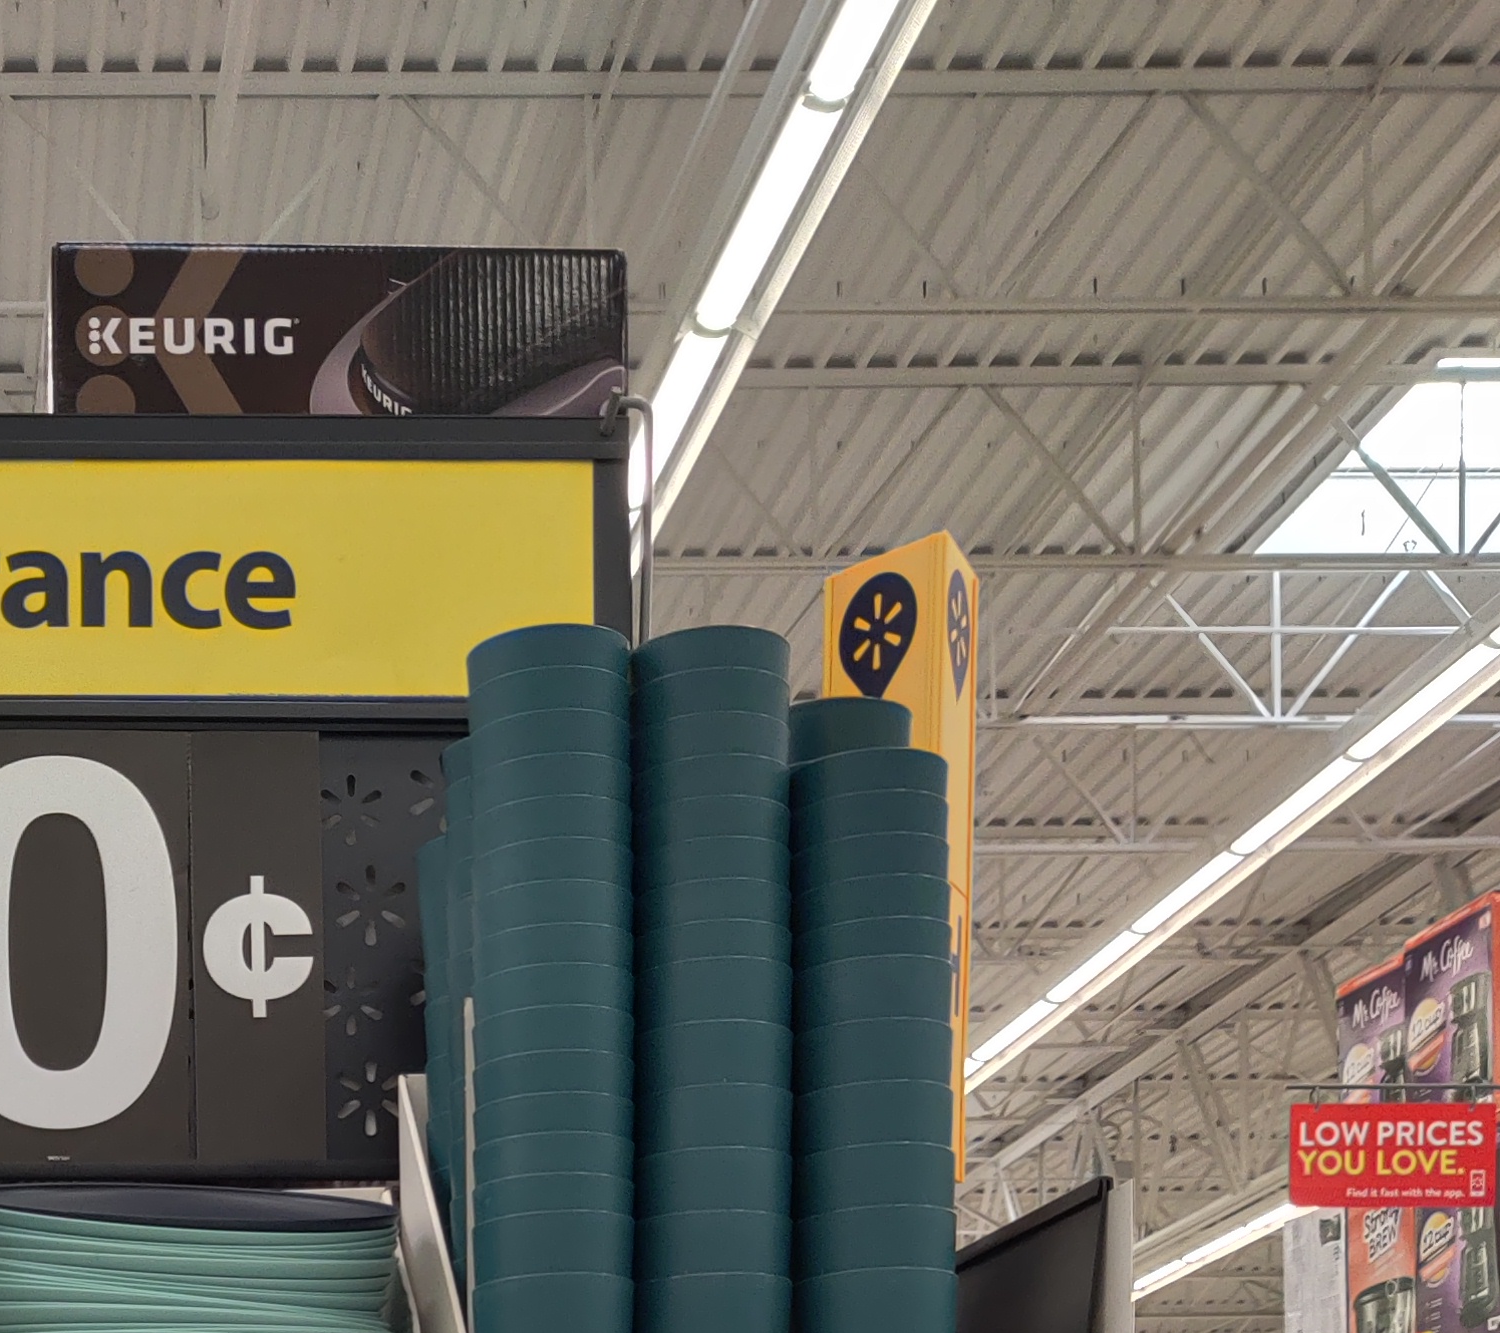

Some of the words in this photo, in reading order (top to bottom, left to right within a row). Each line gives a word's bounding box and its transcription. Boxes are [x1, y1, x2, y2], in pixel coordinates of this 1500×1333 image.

[88, 316, 295, 356] KEURIG
[1299, 1120, 1370, 1147] LOW
[1377, 1120, 1484, 1146] PRICES
[1298, 1149, 1365, 1176] YOU
[1376, 1149, 1466, 1176] LOVE.
[1346, 1187, 1368, 1198] Find
[1369, 1188, 1378, 1198] it
[1380, 1187, 1399, 1198] fast
[1401, 1188, 1423, 1198] with
[1425, 1188, 1442, 1198] the
